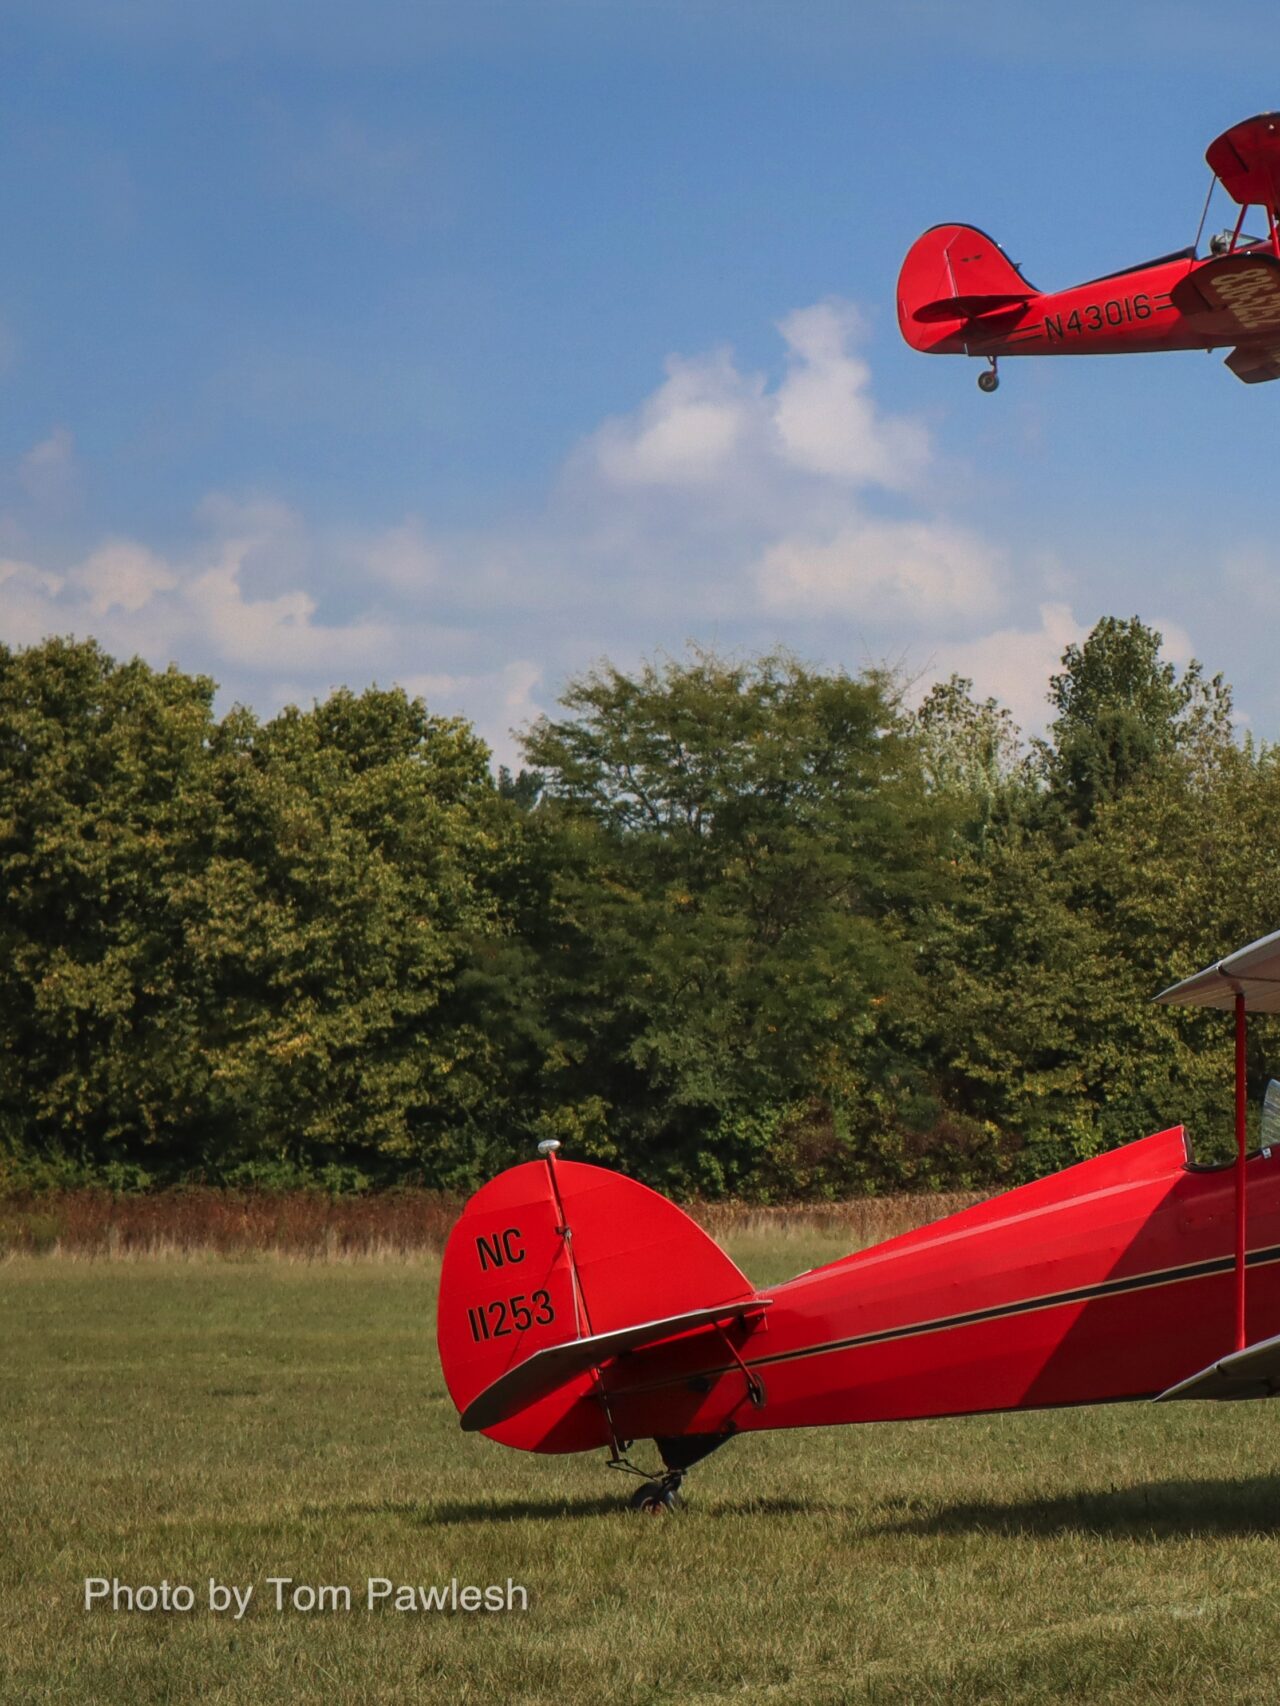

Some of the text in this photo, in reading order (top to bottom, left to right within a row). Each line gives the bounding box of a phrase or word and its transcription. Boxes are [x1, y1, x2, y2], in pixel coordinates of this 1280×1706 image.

[1044, 294, 1152, 340] N43016
[475, 1228, 525, 1271] NC
[468, 1289, 555, 1342] 11253
